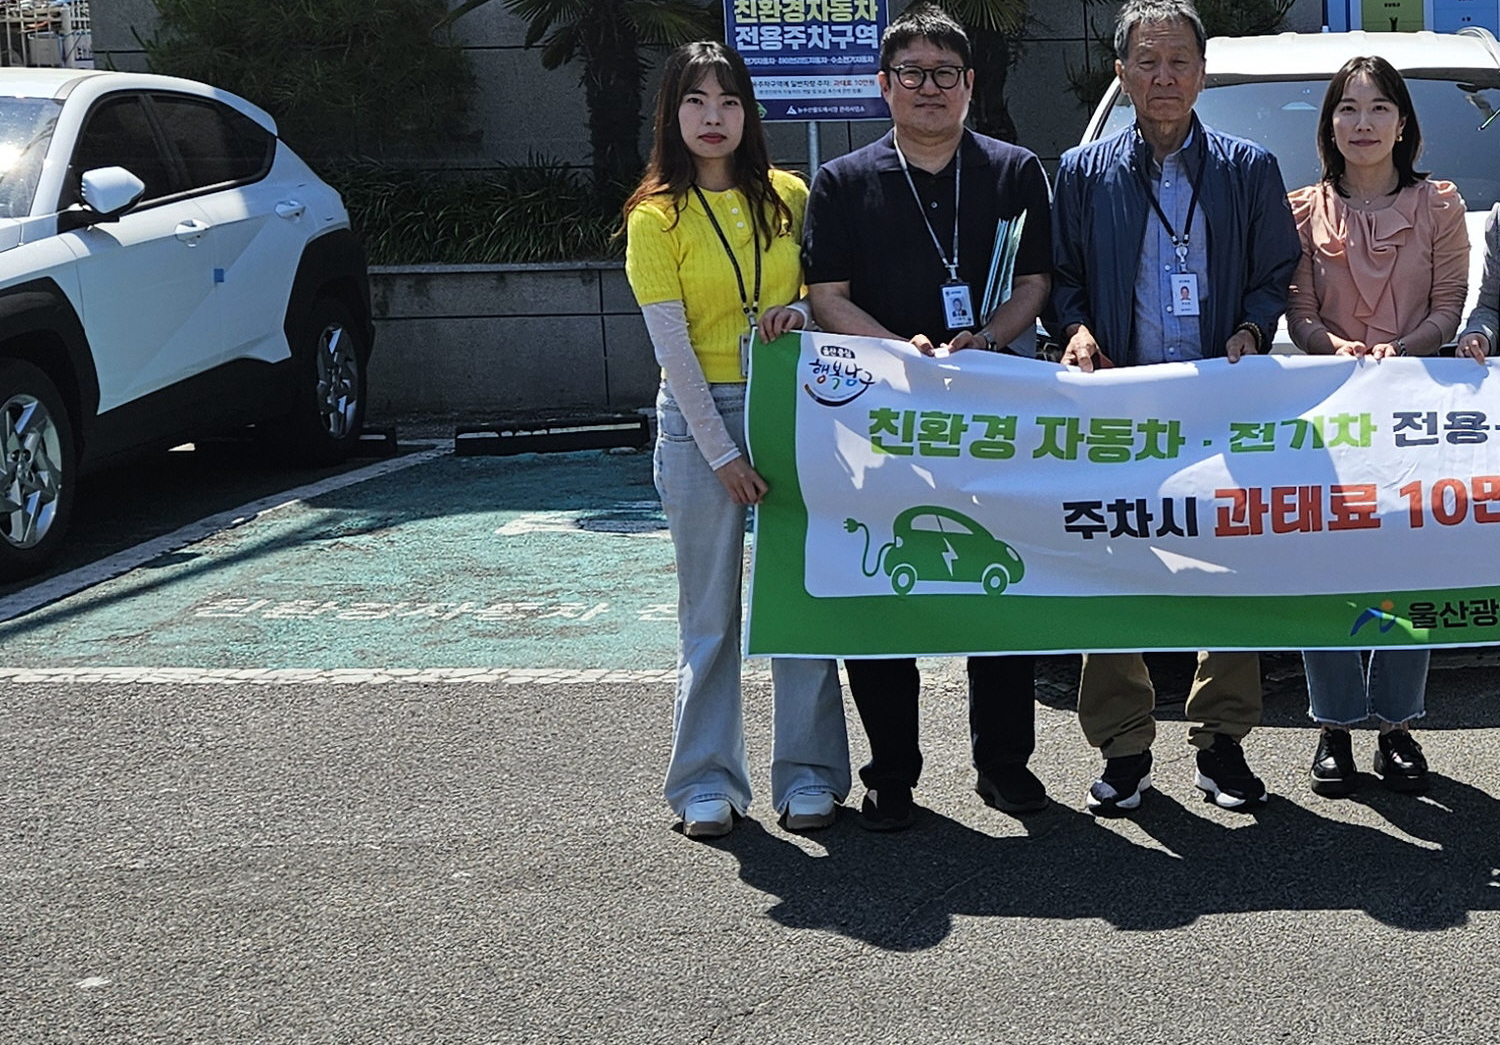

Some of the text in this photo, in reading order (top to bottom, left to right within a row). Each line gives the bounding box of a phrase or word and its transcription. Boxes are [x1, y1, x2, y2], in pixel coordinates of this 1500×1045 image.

[734, 25, 878, 51] 전용주차구역
[808, 358, 876, 391] 행복남구
[868, 408, 1018, 460] 친환경
[1032, 416, 1186, 463] 자동차
[1229, 412, 1378, 454] 전기차
[1063, 497, 1199, 540] 주차시
[1214, 484, 1381, 538] 과태료
